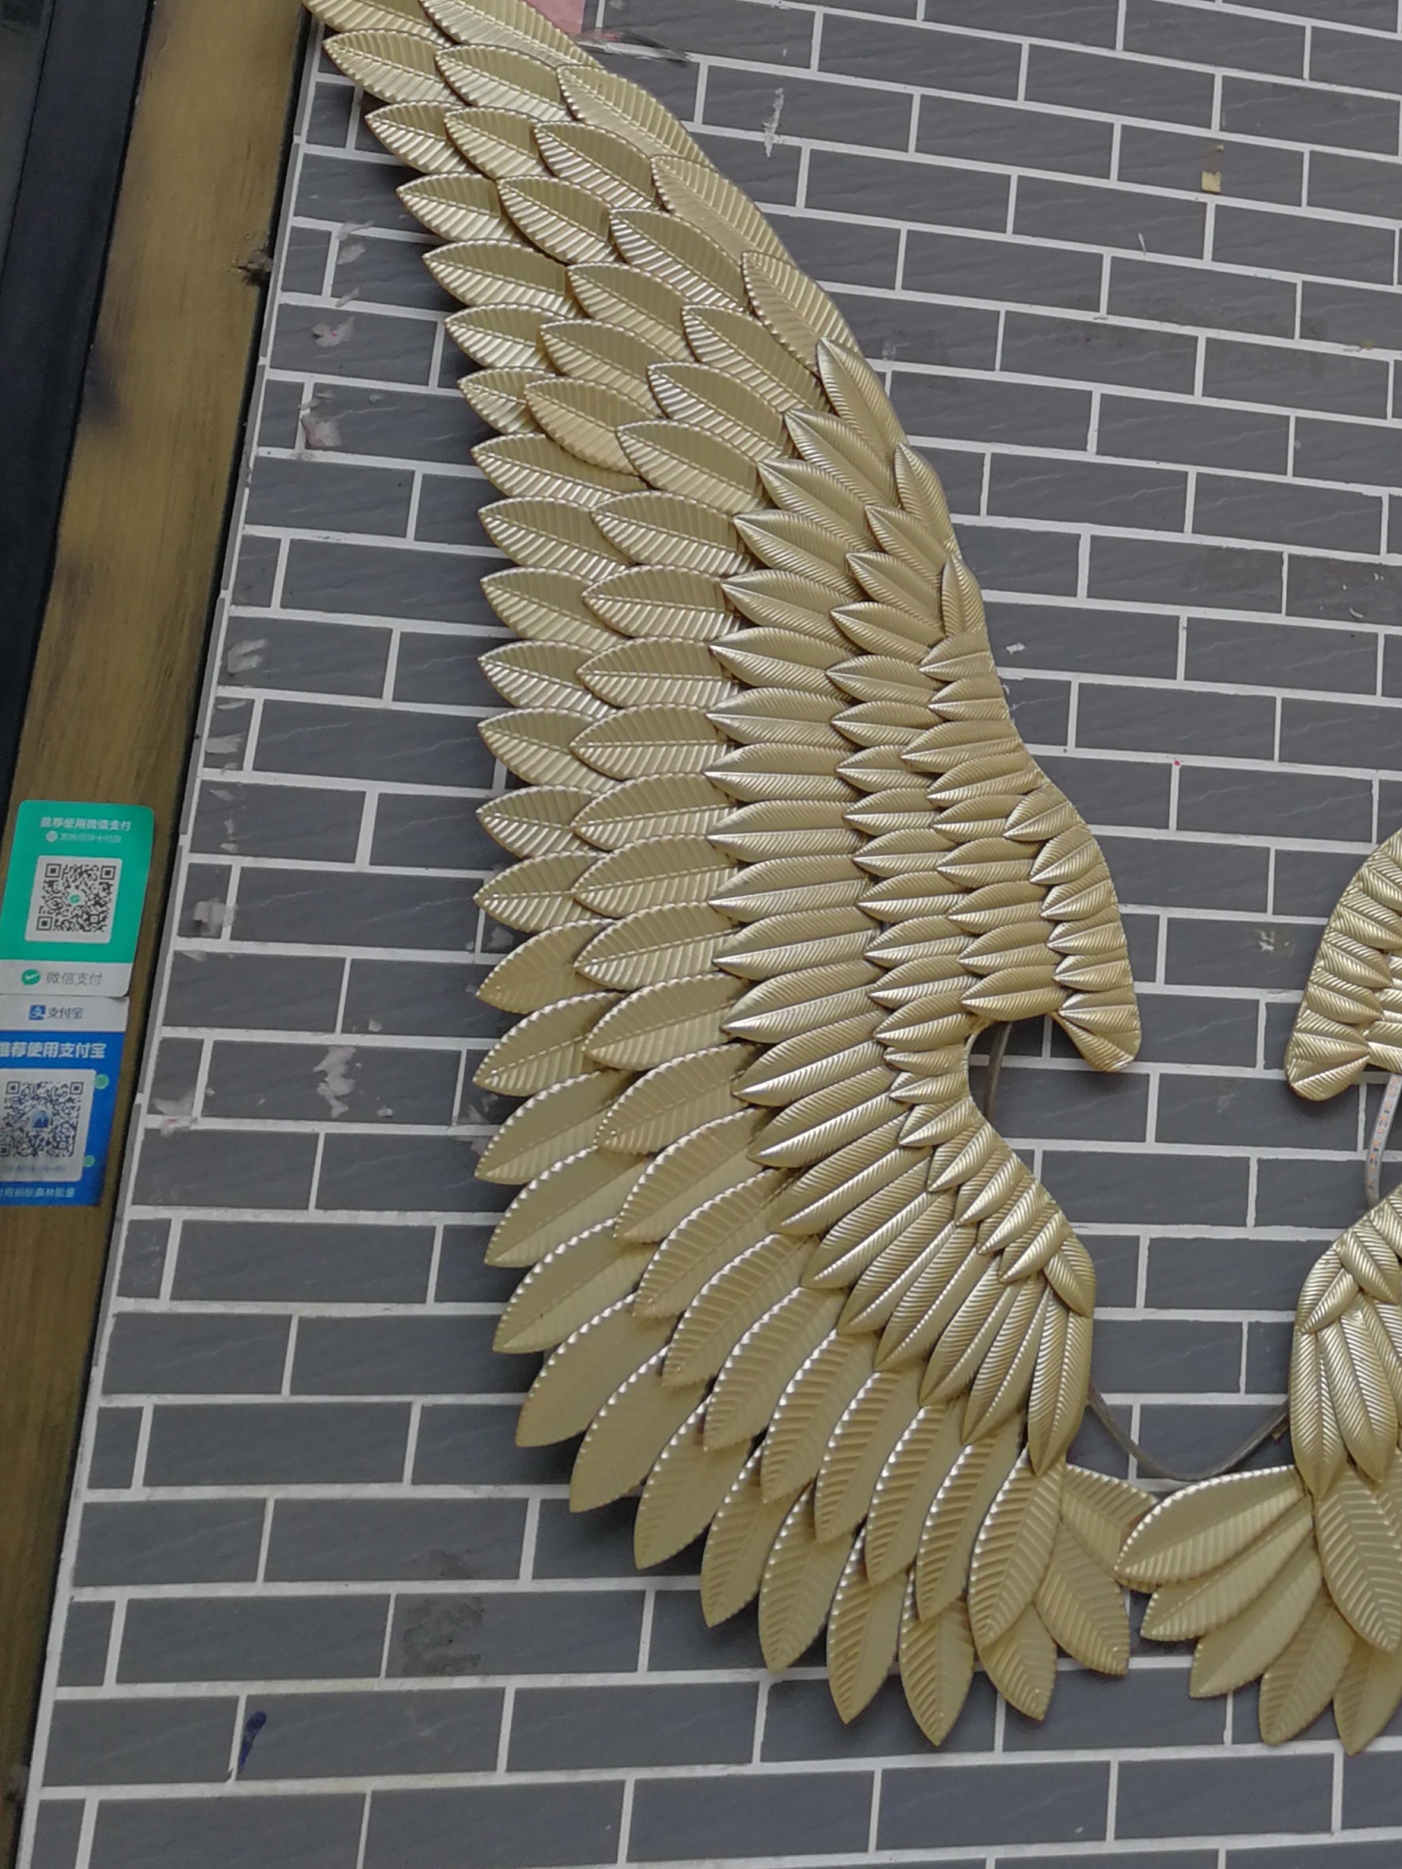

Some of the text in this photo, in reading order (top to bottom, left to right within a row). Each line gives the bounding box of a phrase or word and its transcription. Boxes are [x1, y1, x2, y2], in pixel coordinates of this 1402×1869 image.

[46, 971, 103, 985] 微信支付
[47, 1007, 84, 1019] 支付宝
